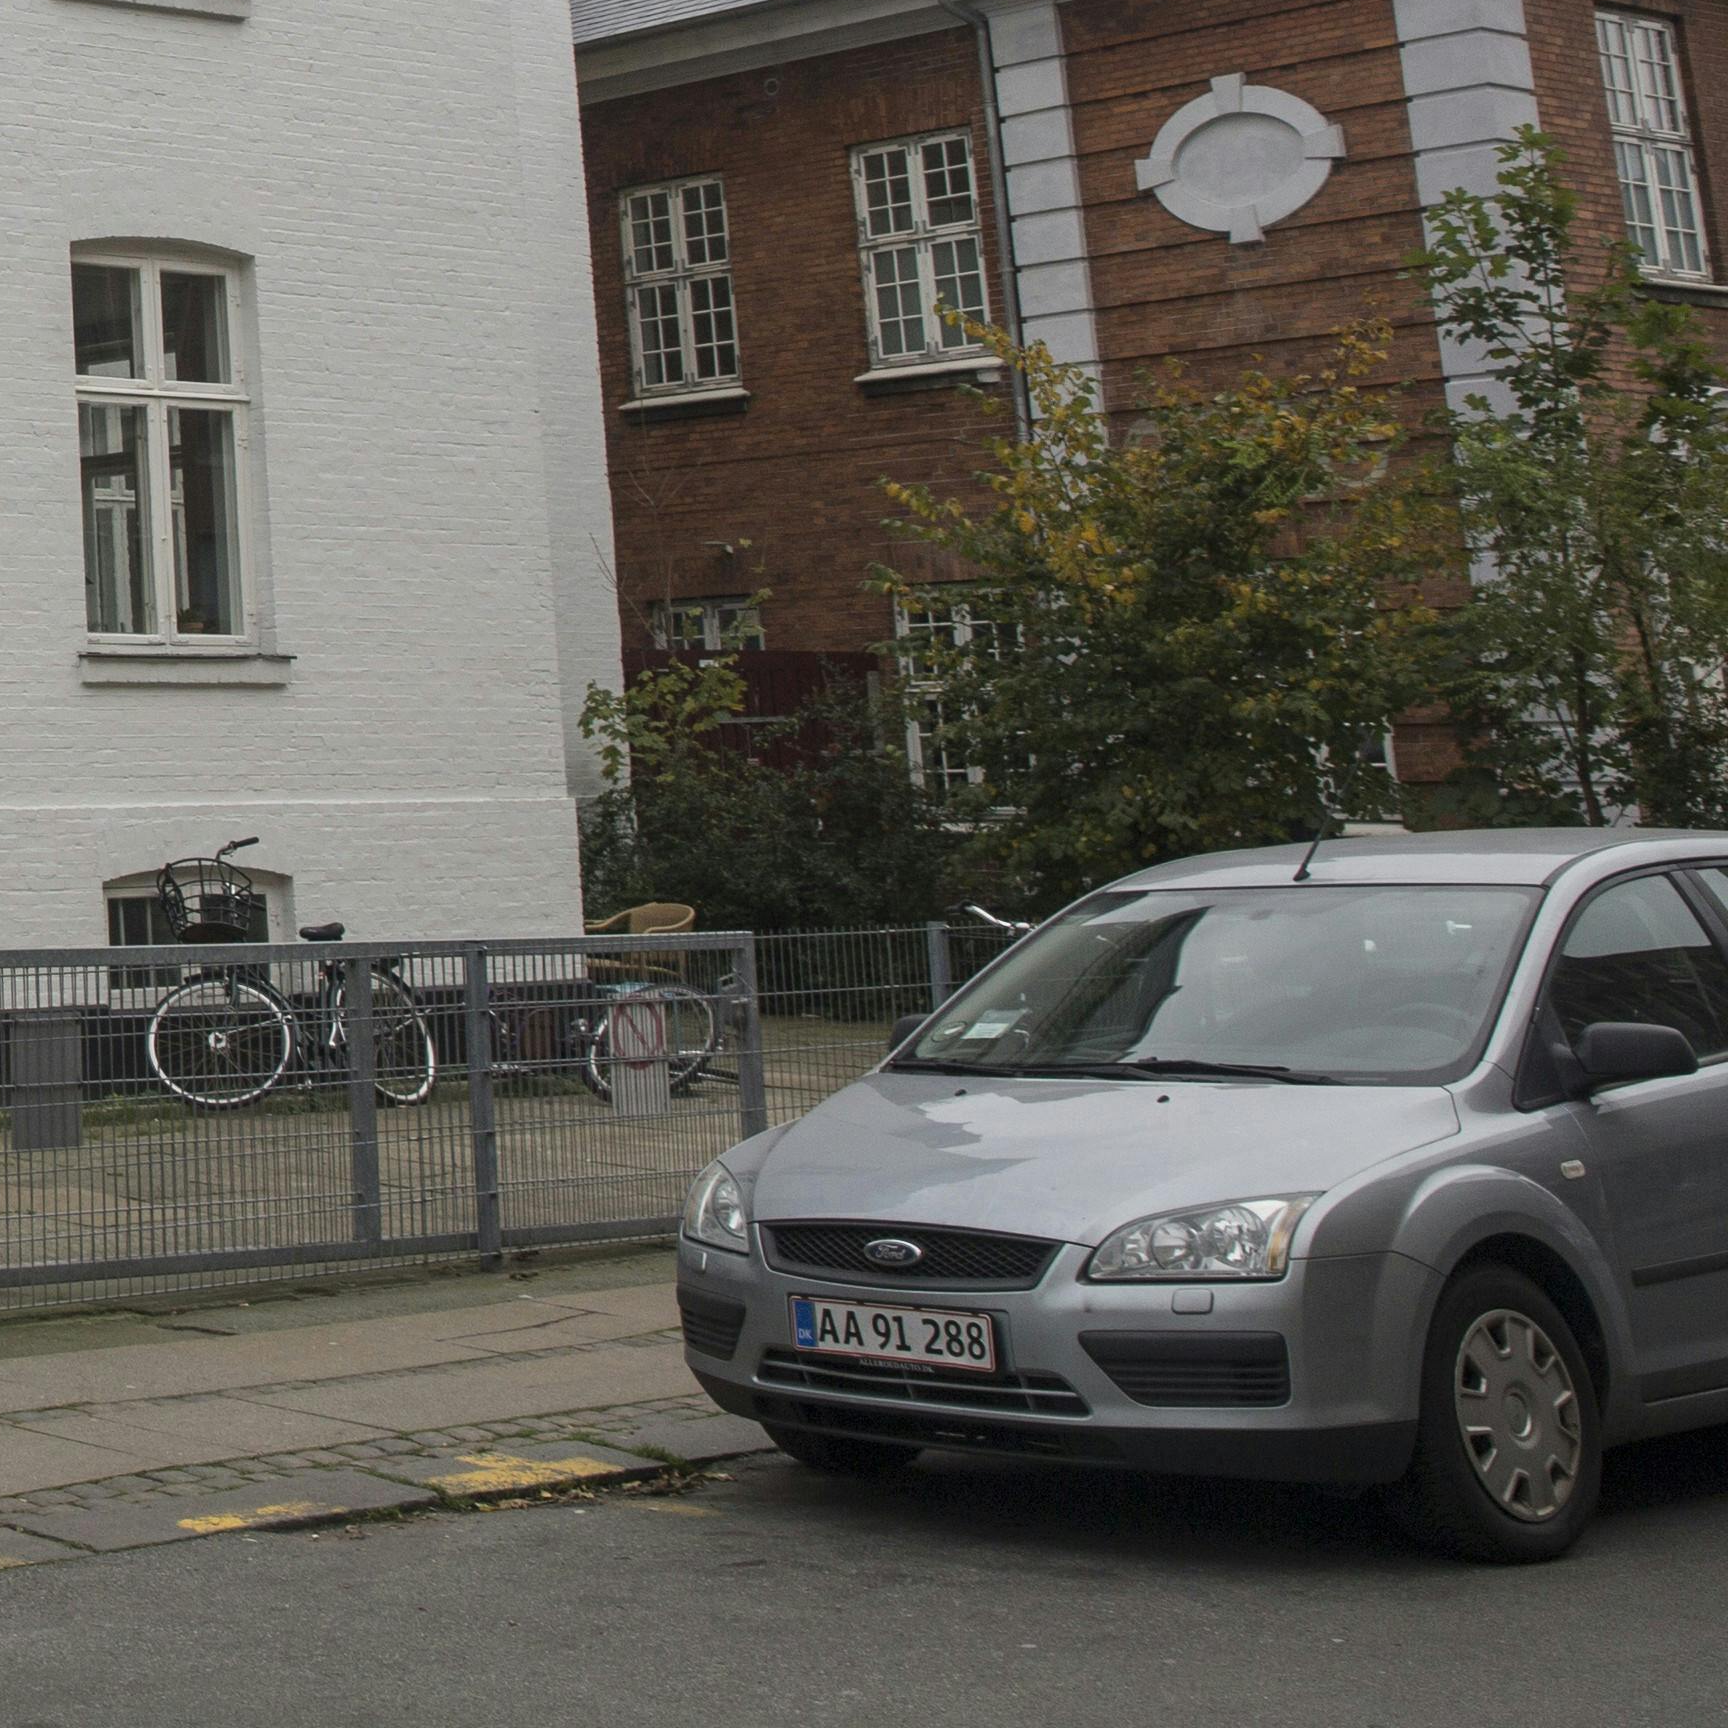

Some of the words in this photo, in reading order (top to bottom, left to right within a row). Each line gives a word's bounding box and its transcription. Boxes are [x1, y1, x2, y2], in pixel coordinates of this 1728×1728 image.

[875, 1243, 906, 1260] Ford
[798, 1328, 813, 1340] DK
[819, 1308, 864, 1347] AA
[872, 1313, 911, 1352] 91
[921, 1318, 986, 1360] 288
